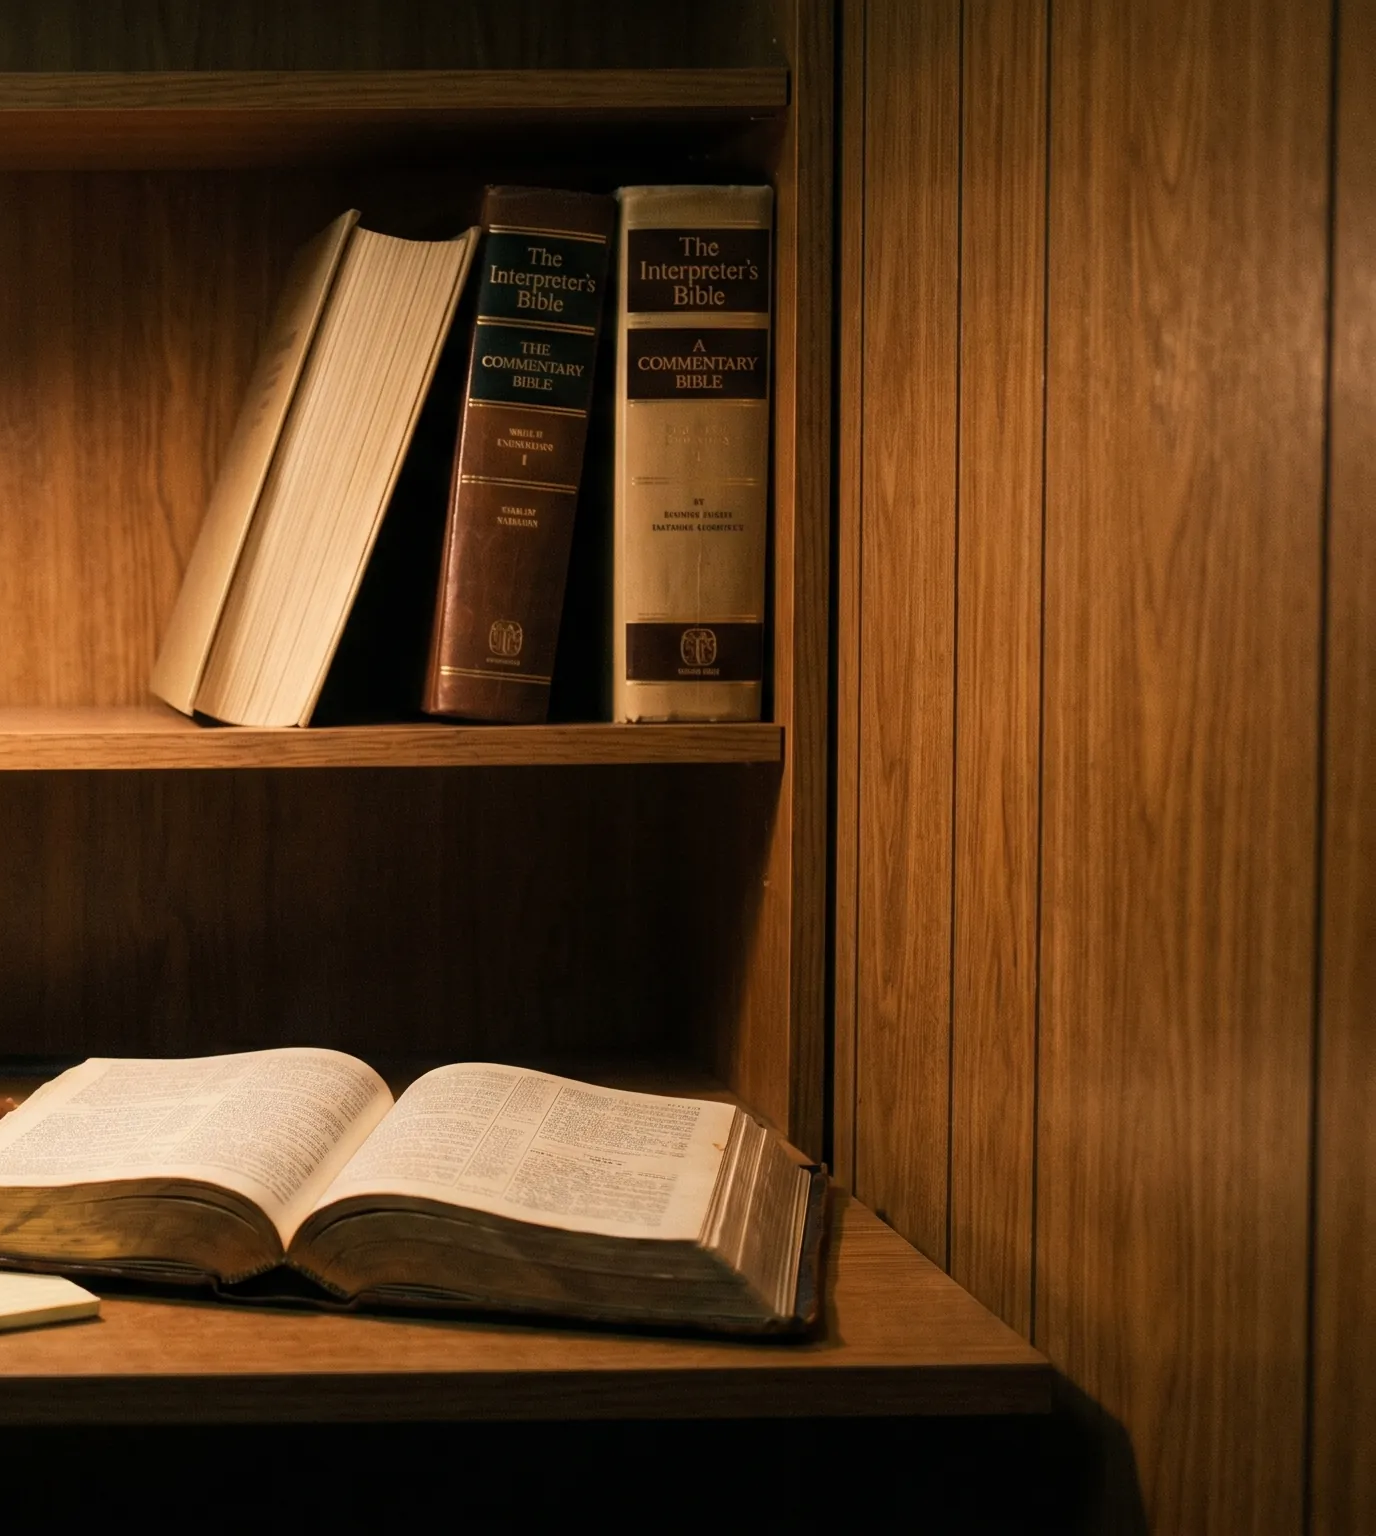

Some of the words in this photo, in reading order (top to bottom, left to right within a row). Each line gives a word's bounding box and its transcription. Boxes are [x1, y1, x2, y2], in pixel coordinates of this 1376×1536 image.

[679, 236, 719, 257] The
[528, 247, 562, 267] The
[489, 265, 596, 293] Interpreter's
[640, 259, 758, 287] Interpreter's
[517, 290, 564, 312] Bible
[673, 285, 725, 306] Bible
[520, 341, 551, 356] THE
[692, 339, 706, 352] A
[482, 354, 584, 378] COMMENTARY
[637, 356, 758, 371] COMMENTARY
[512, 375, 553, 391] BIBLE
[675, 374, 723, 389] BIBLE
